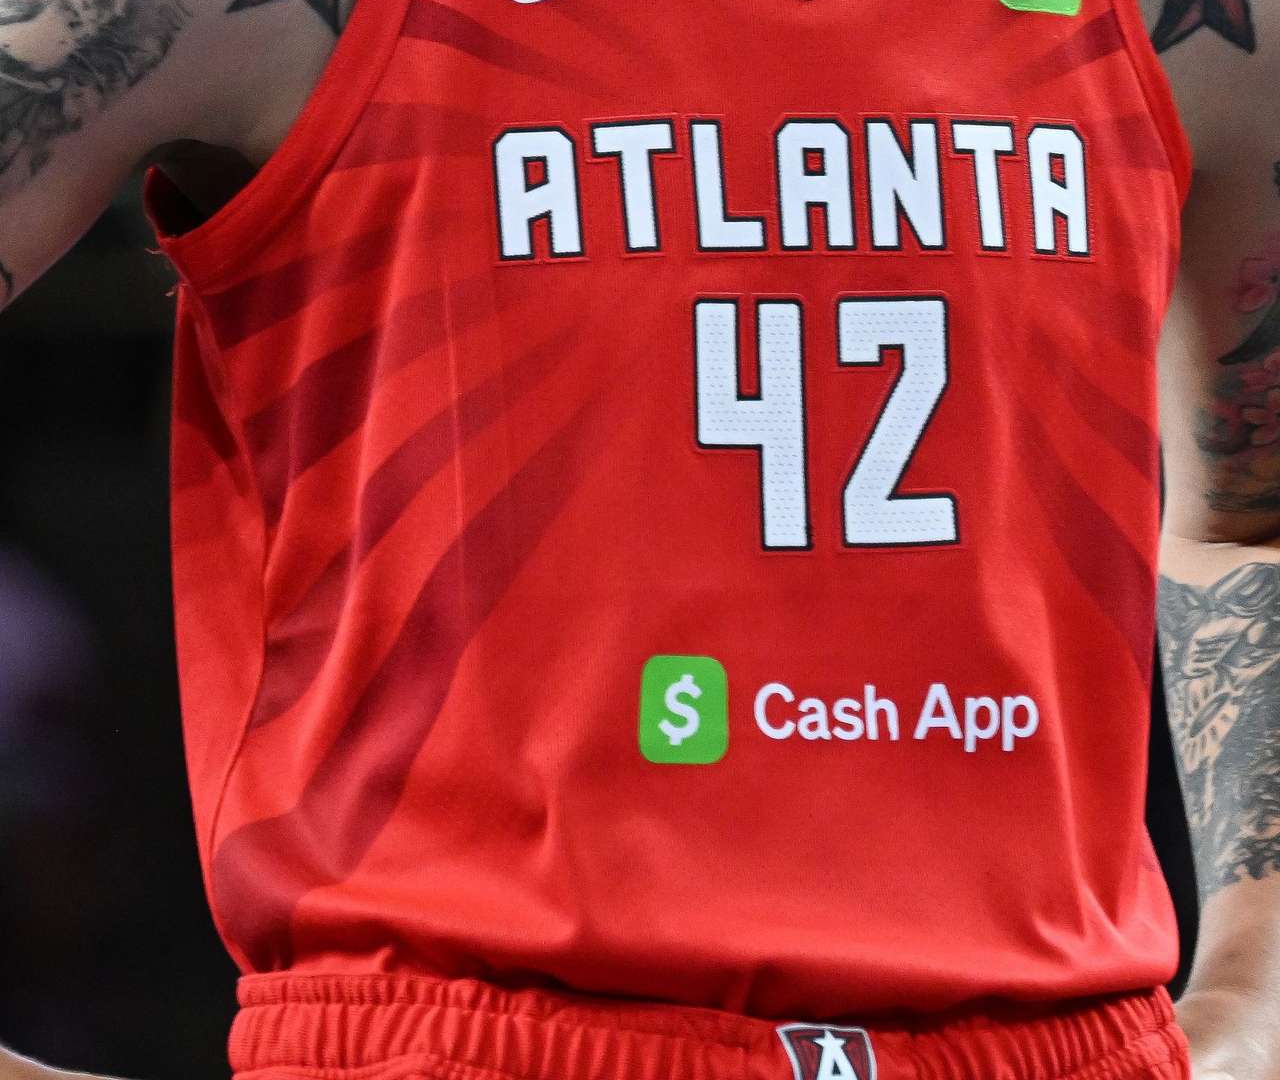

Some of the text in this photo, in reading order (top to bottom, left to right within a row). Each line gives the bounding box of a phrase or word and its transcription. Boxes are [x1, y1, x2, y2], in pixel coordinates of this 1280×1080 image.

[491, 117, 1089, 260] ATLANTA
[692, 291, 960, 551] 42
[753, 683, 900, 741] Cash
[914, 683, 1039, 752] App
